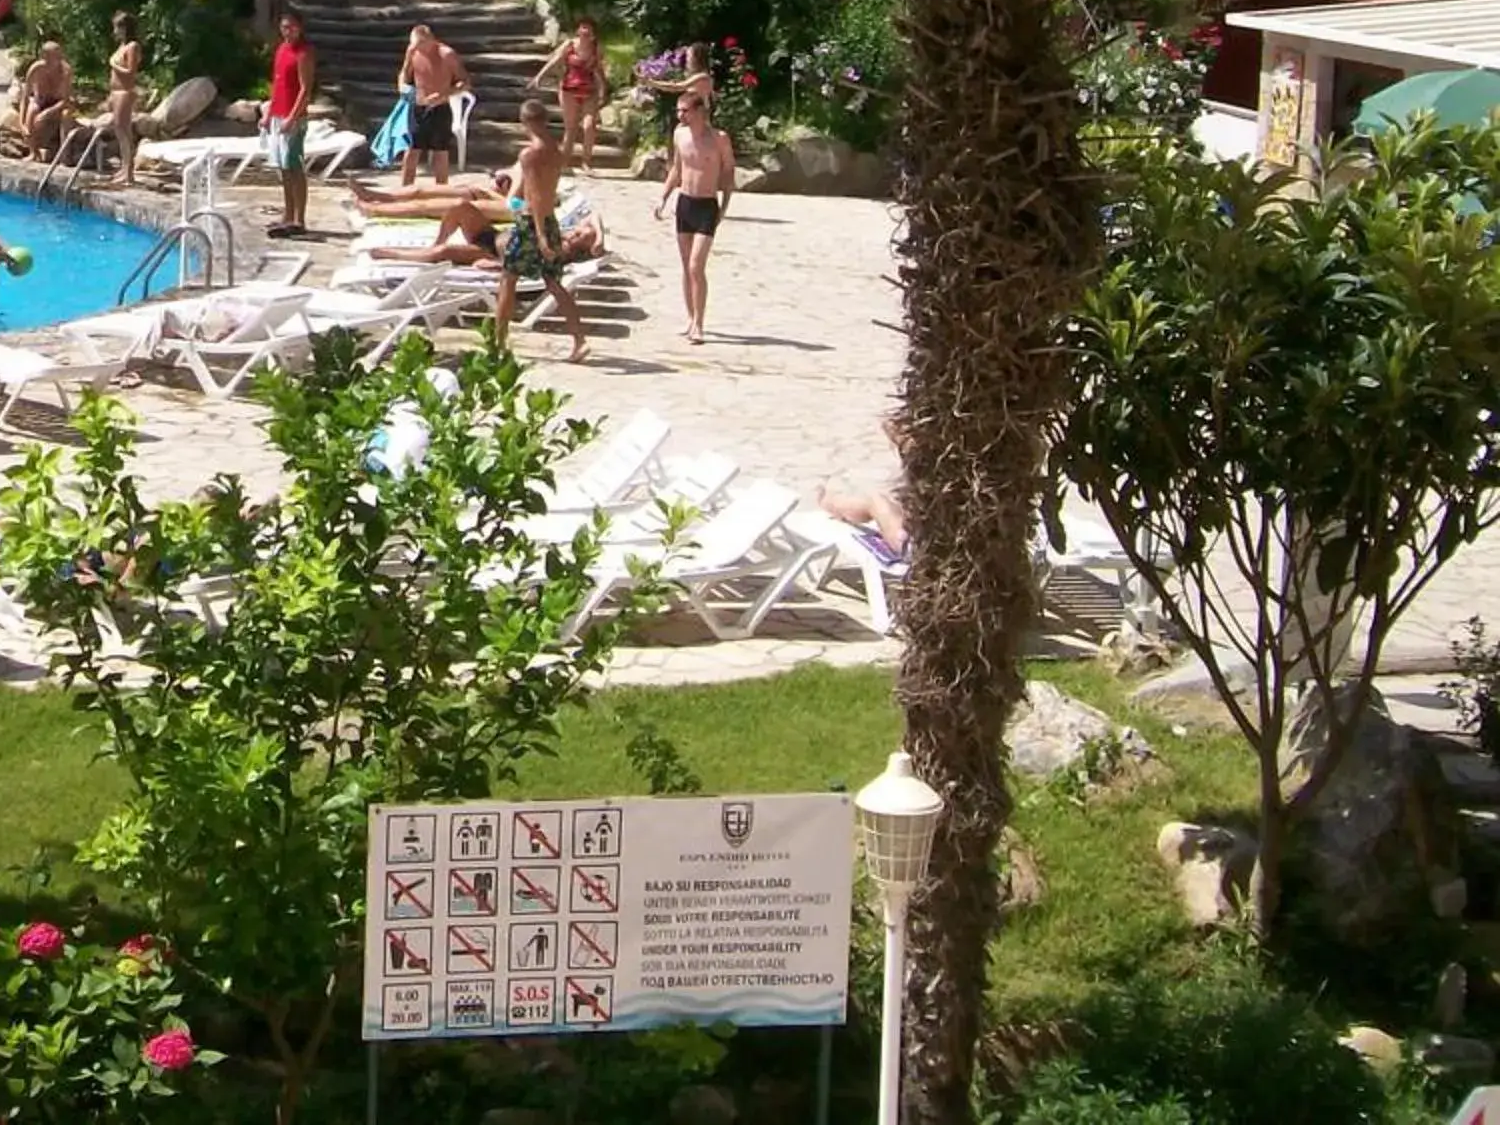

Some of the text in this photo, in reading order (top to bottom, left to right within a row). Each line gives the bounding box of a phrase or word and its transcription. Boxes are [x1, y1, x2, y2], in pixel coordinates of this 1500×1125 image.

[644, 878, 792, 892] BAJO SU RESPONSABILIDAD
[643, 896, 679, 909] UNTER
[643, 928, 677, 941] SOTTO
[678, 928, 692, 939] LA
[694, 926, 740, 939] RELATIVA
[641, 943, 677, 955] UNDER
[681, 943, 709, 954] YOUR
[640, 976, 665, 989] ПОД
[513, 985, 550, 1002] S.O.S
[528, 1004, 549, 1019] 112
